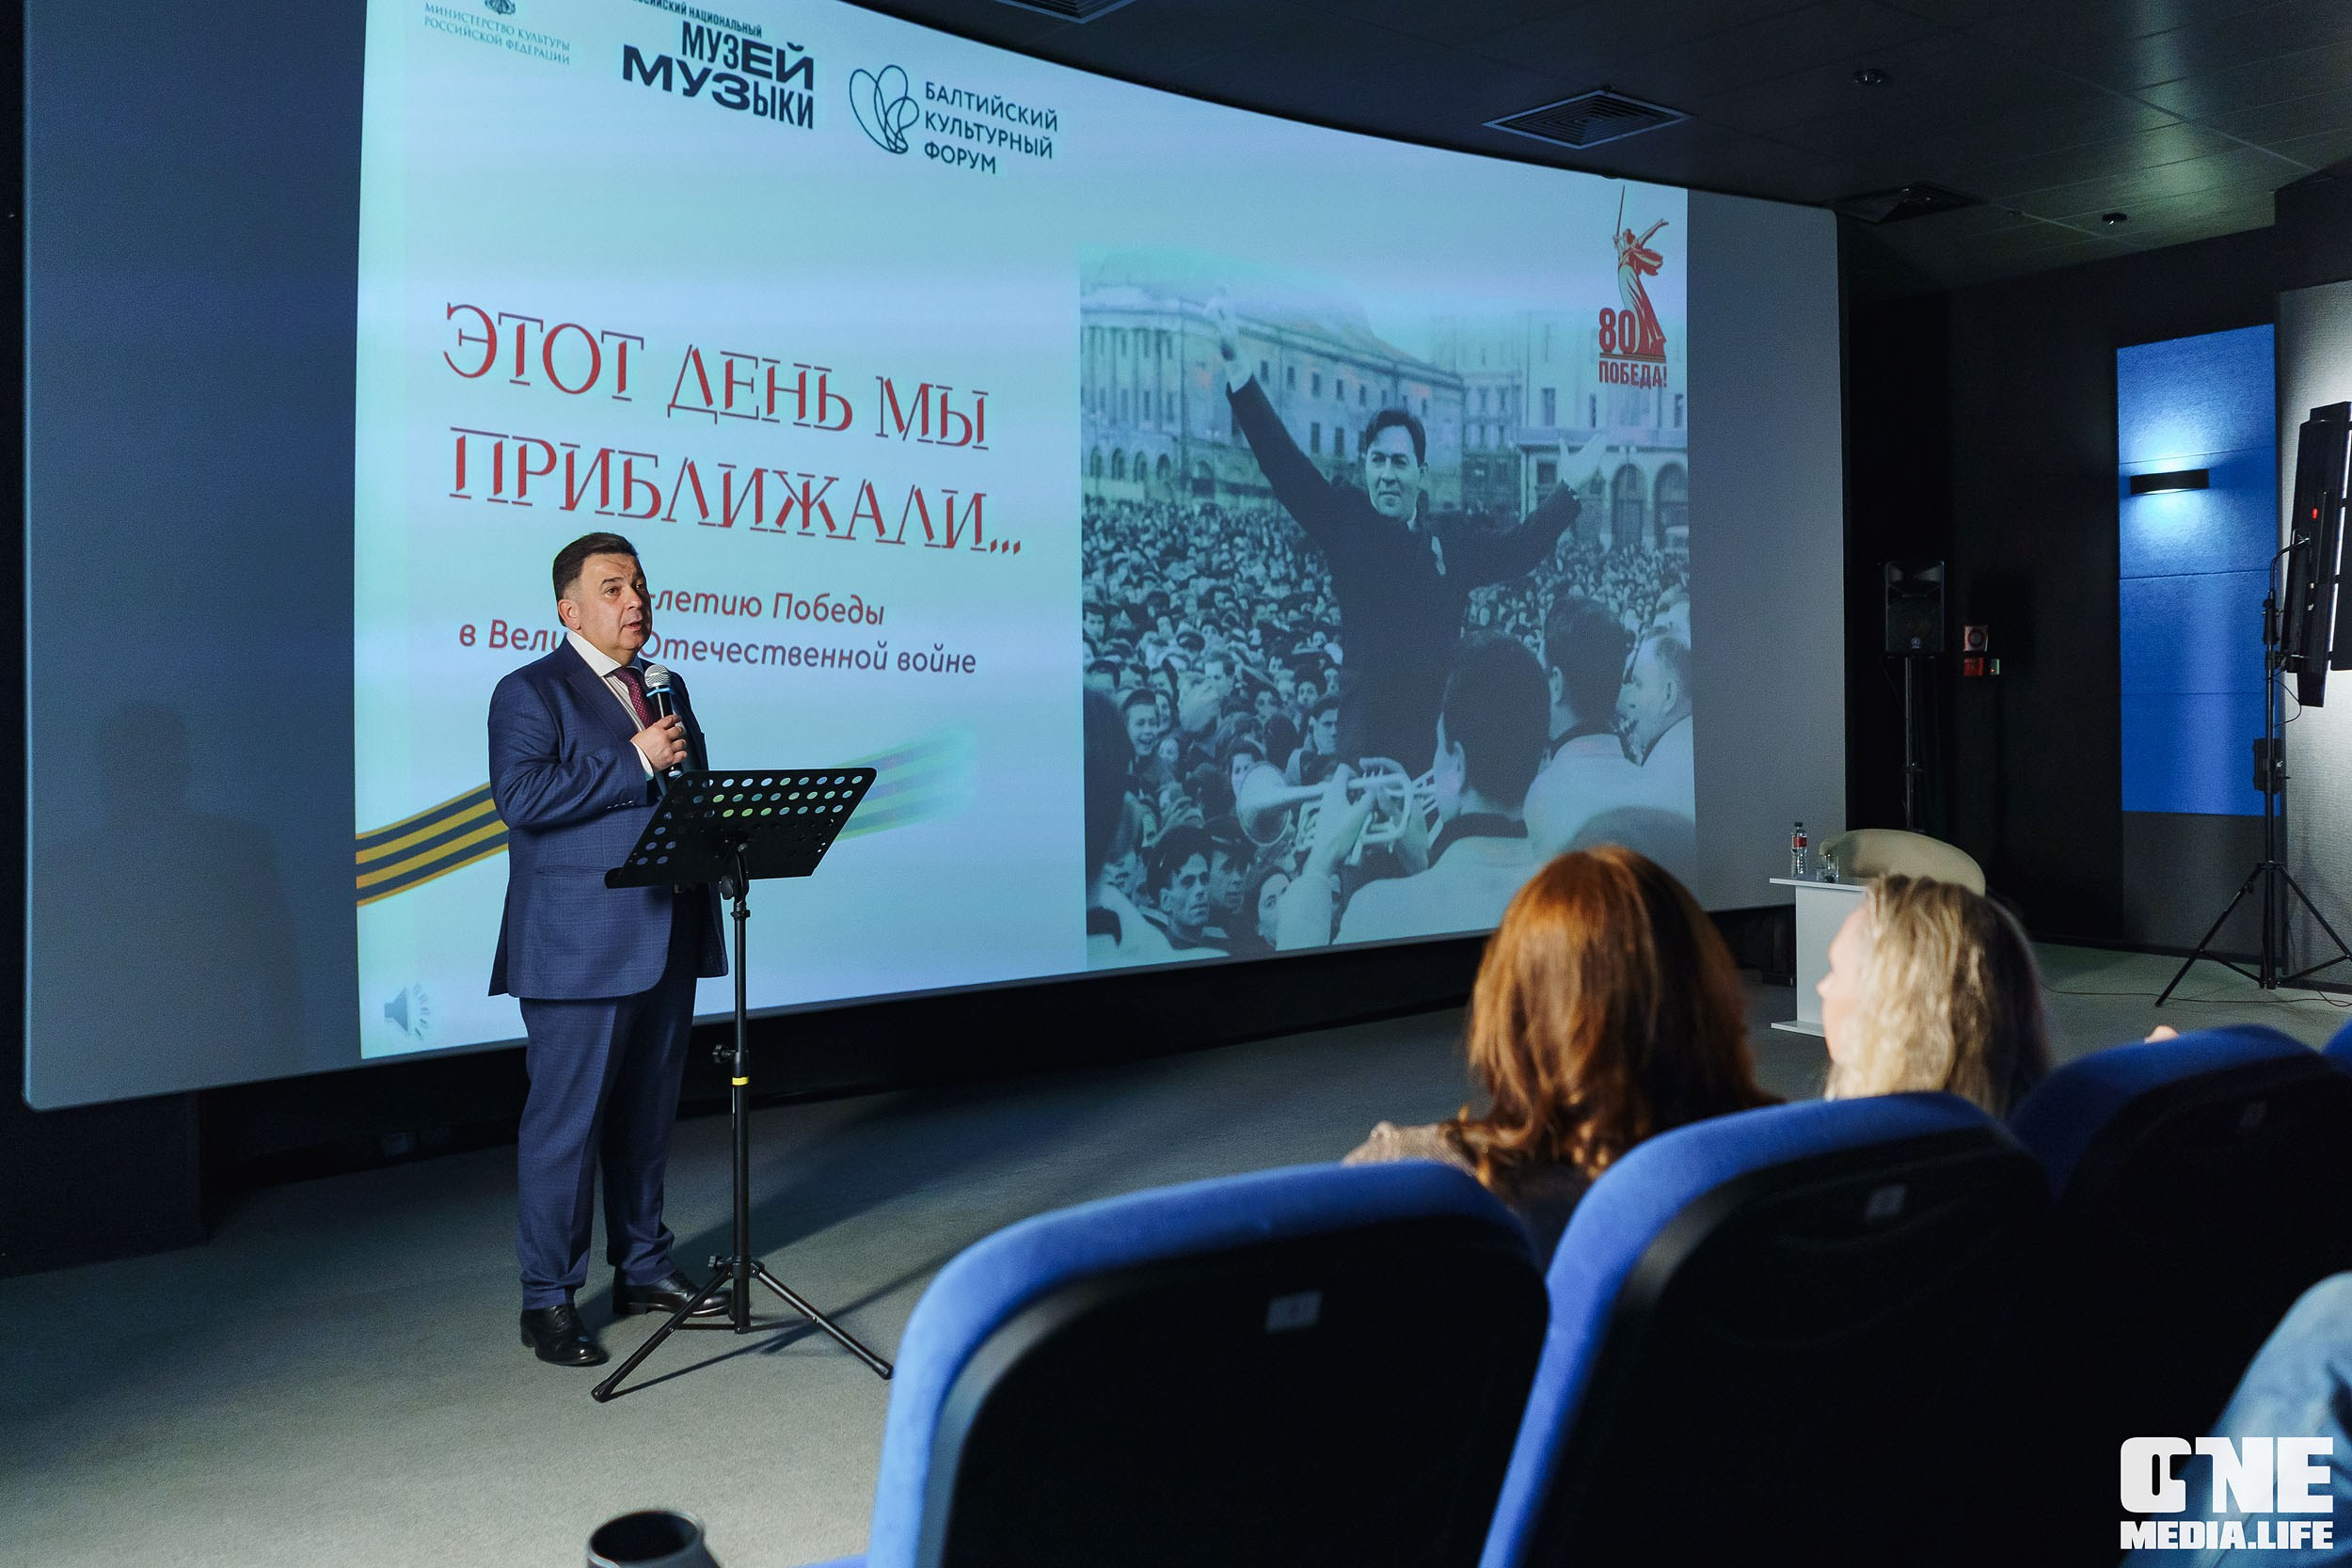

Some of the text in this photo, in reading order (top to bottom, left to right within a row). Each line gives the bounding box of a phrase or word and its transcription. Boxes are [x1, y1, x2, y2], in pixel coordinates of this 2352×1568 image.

[424, 3, 570, 51] МИНИСТЕРСТВО КУЛЬТУРЫ
[424, 17, 569, 65] РОССИЙСКОЙ ФЕДЕРАЦИИ
[689, 7, 762, 39] НАЦИОНАЛЬНЫЙ
[681, 20, 814, 91] МУЗЕЙ
[623, 43, 814, 130] МУЗЫКИ
[925, 82, 1057, 131] БАЛТИЙСКИЙ
[924, 141, 996, 174] ФОРУМ
[925, 110, 1053, 159] КУЛЬТУРНЫЙ
[1598, 308, 1636, 354] 80
[443, 302, 989, 450] ЭТОТ ДЕНЬ МЫ
[1598, 360, 1667, 388] ПОБЕДА!
[449, 426, 1022, 555] ПРИБЛИЖАЛИ...
[649, 589, 884, 626] -летию Победы
[459, 624, 476, 647] в
[641, 630, 888, 671] Отечественной
[897, 643, 977, 673] войне
